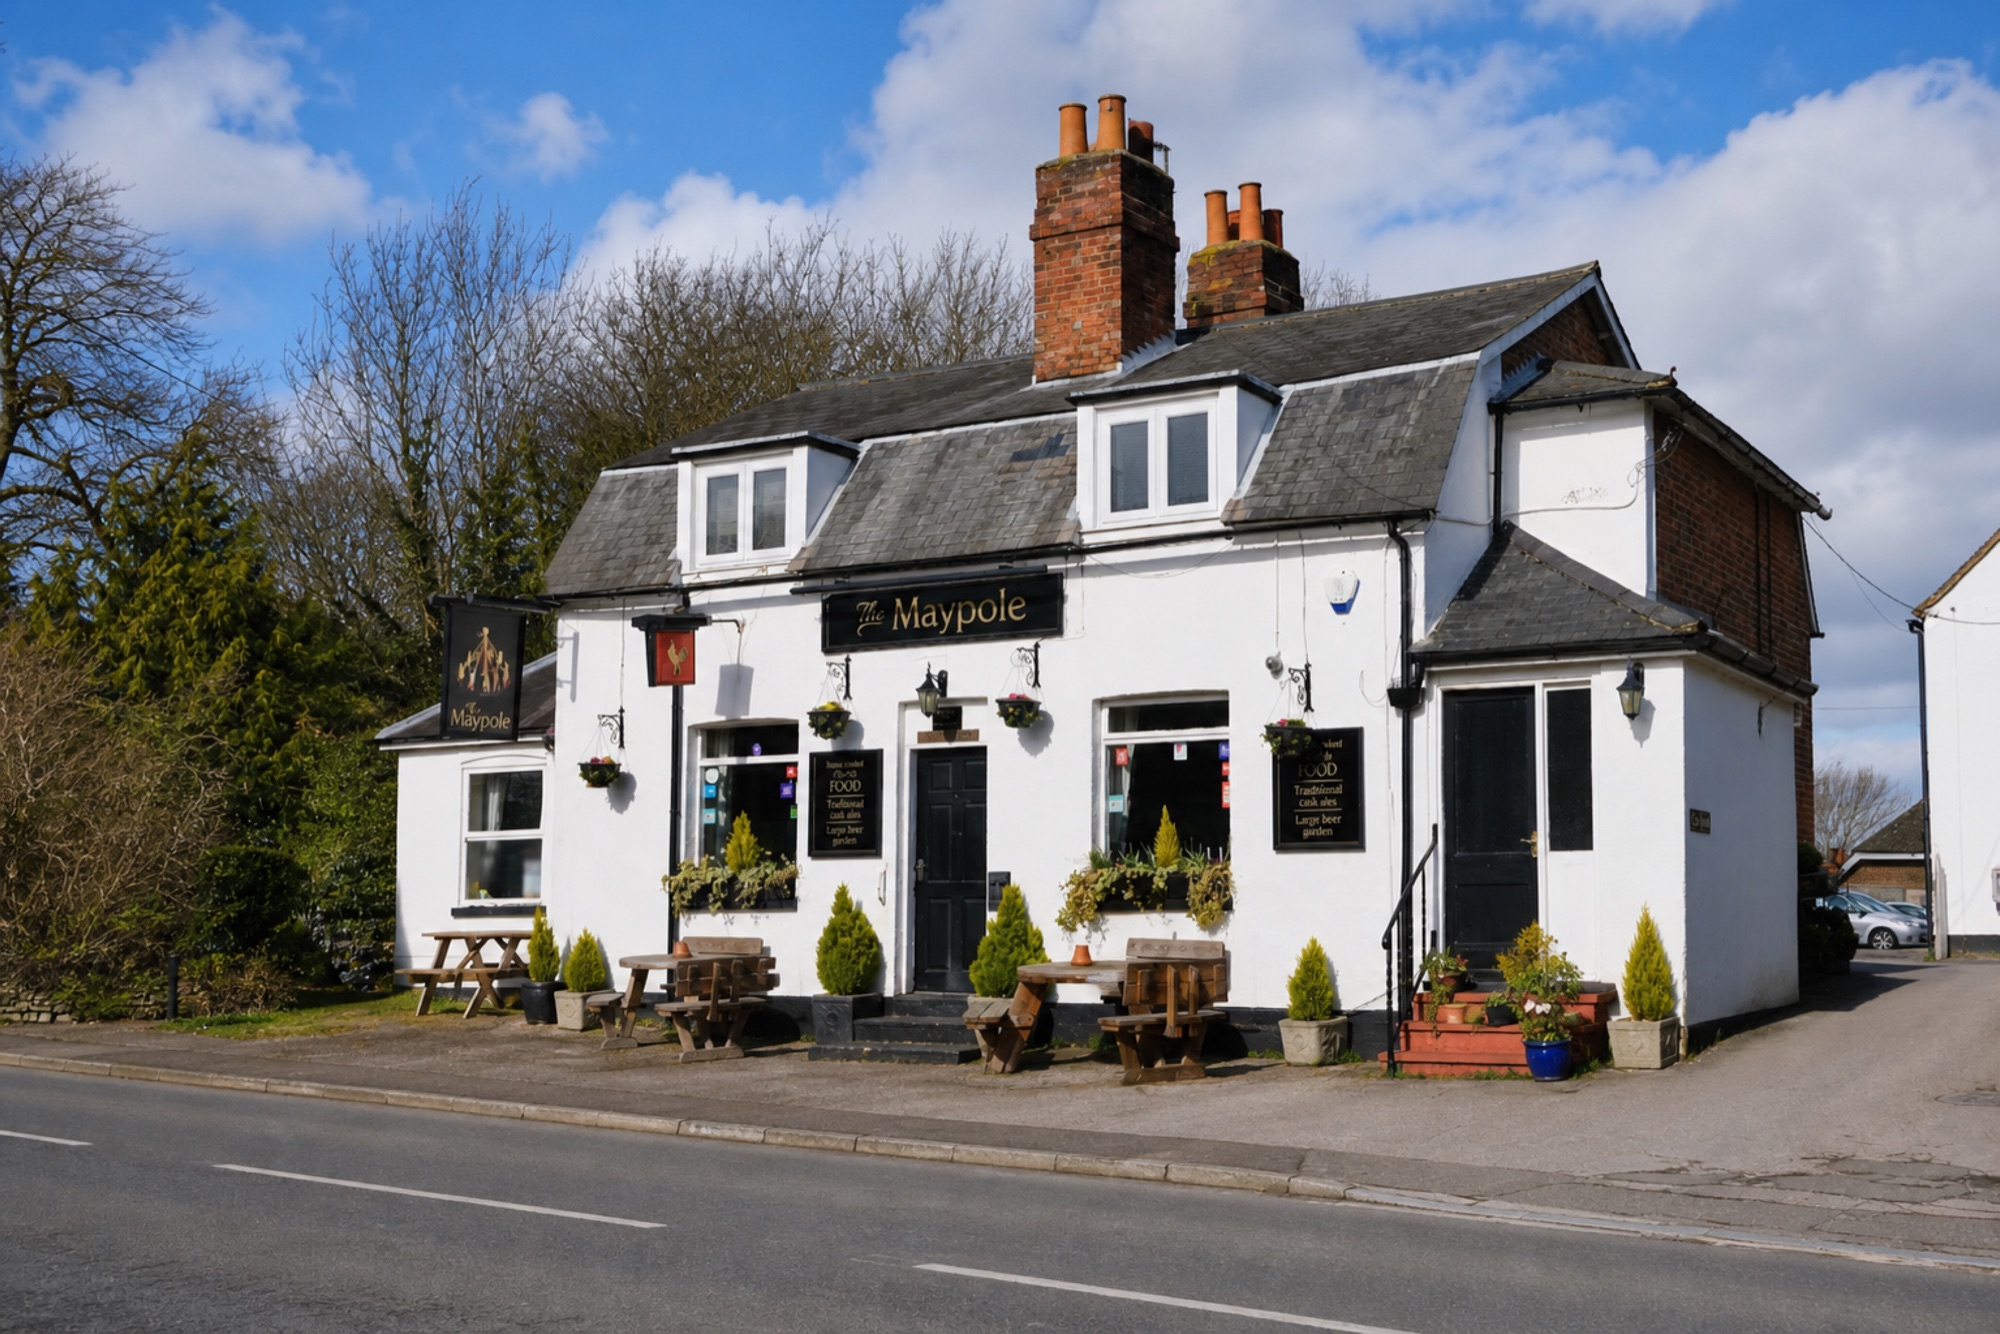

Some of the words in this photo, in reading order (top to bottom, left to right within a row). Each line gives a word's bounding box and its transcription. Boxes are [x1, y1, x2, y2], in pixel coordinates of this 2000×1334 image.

[856, 600, 885, 637] The
[891, 588, 1027, 635] Maypole
[450, 707, 512, 733] Maypole
[1298, 762, 1338, 777] FOOD
[829, 779, 862, 793] FOOD
[1293, 783, 1343, 796] Traditional
[1295, 814, 1320, 827] Large
[1321, 813, 1342, 824] beer
[1302, 826, 1334, 839] garden
